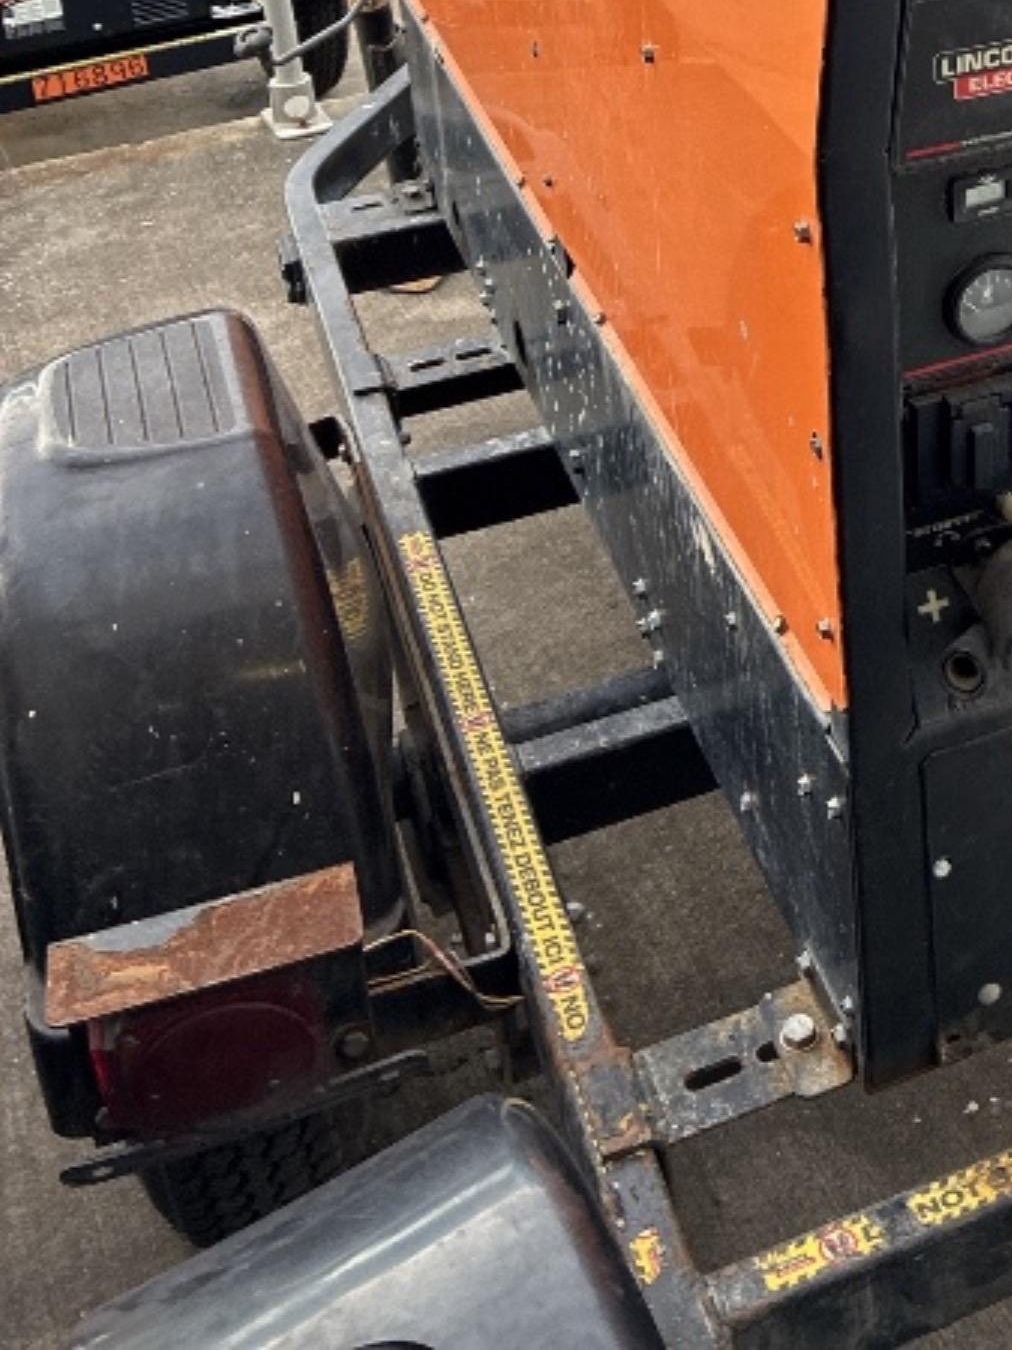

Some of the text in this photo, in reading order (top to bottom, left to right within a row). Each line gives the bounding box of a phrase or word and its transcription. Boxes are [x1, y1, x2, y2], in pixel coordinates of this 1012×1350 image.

[484, 757, 507, 792] PAS
[496, 795, 525, 847] TENEZ
[515, 849, 556, 931] DEBOUT
[560, 994, 587, 1031] NO
[916, 1181, 980, 1220] NOT
